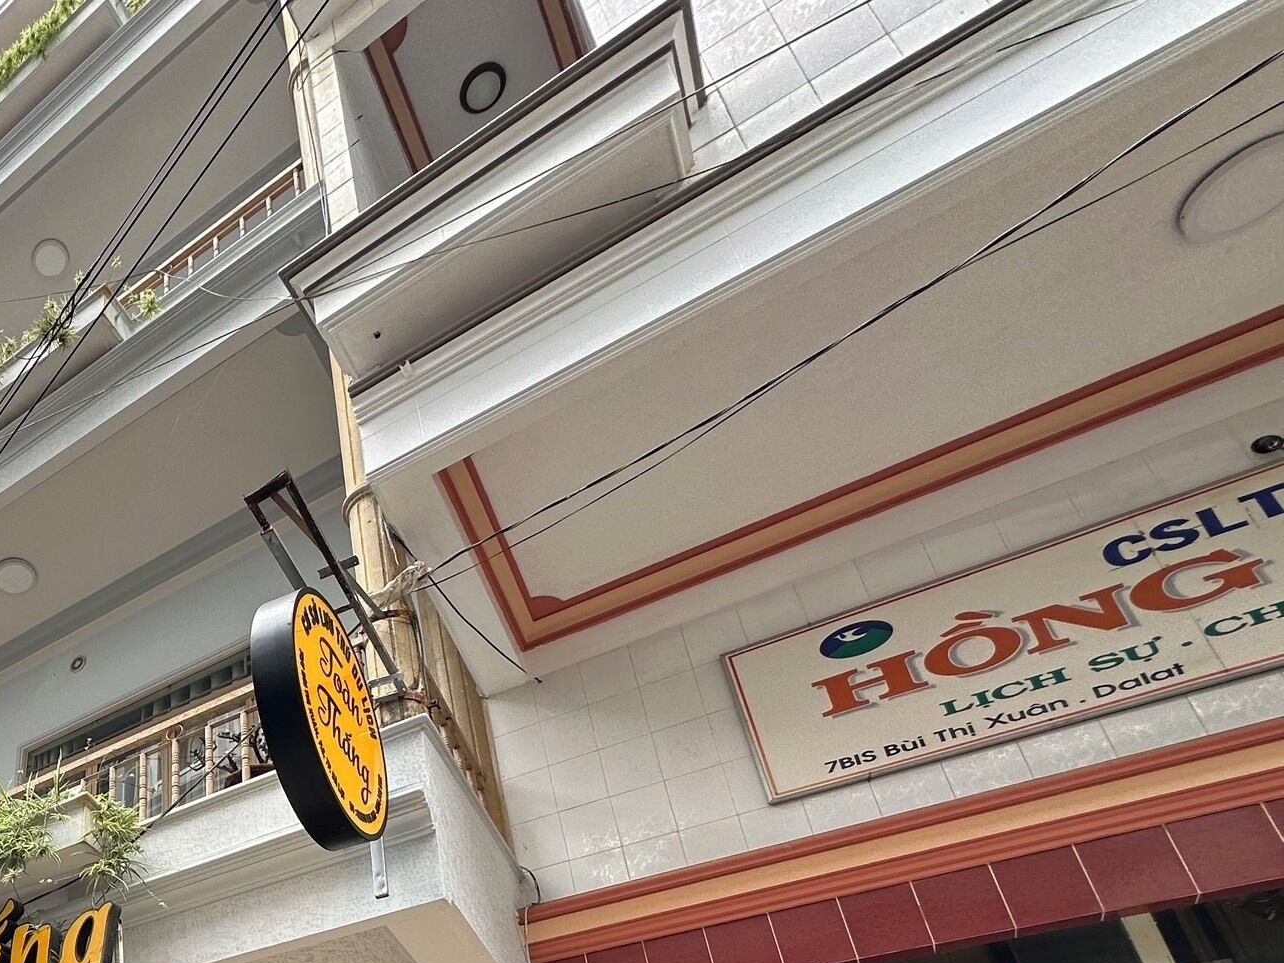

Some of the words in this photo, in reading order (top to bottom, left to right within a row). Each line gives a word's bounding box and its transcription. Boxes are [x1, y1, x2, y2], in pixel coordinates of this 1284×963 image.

[319, 636, 363, 726] Toàn
[811, 549, 1264, 718] HỒNG
[940, 667, 1072, 717] LỊCH
[1088, 636, 1162, 672] SỰ
[317, 684, 371, 805] Thắng
[824, 750, 877, 773] 7BIS
[883, 736, 927, 757] Bùi
[933, 721, 976, 742] Thị
[984, 699, 1069, 729] Xuân
[1092, 662, 1186, 698] Dalat
